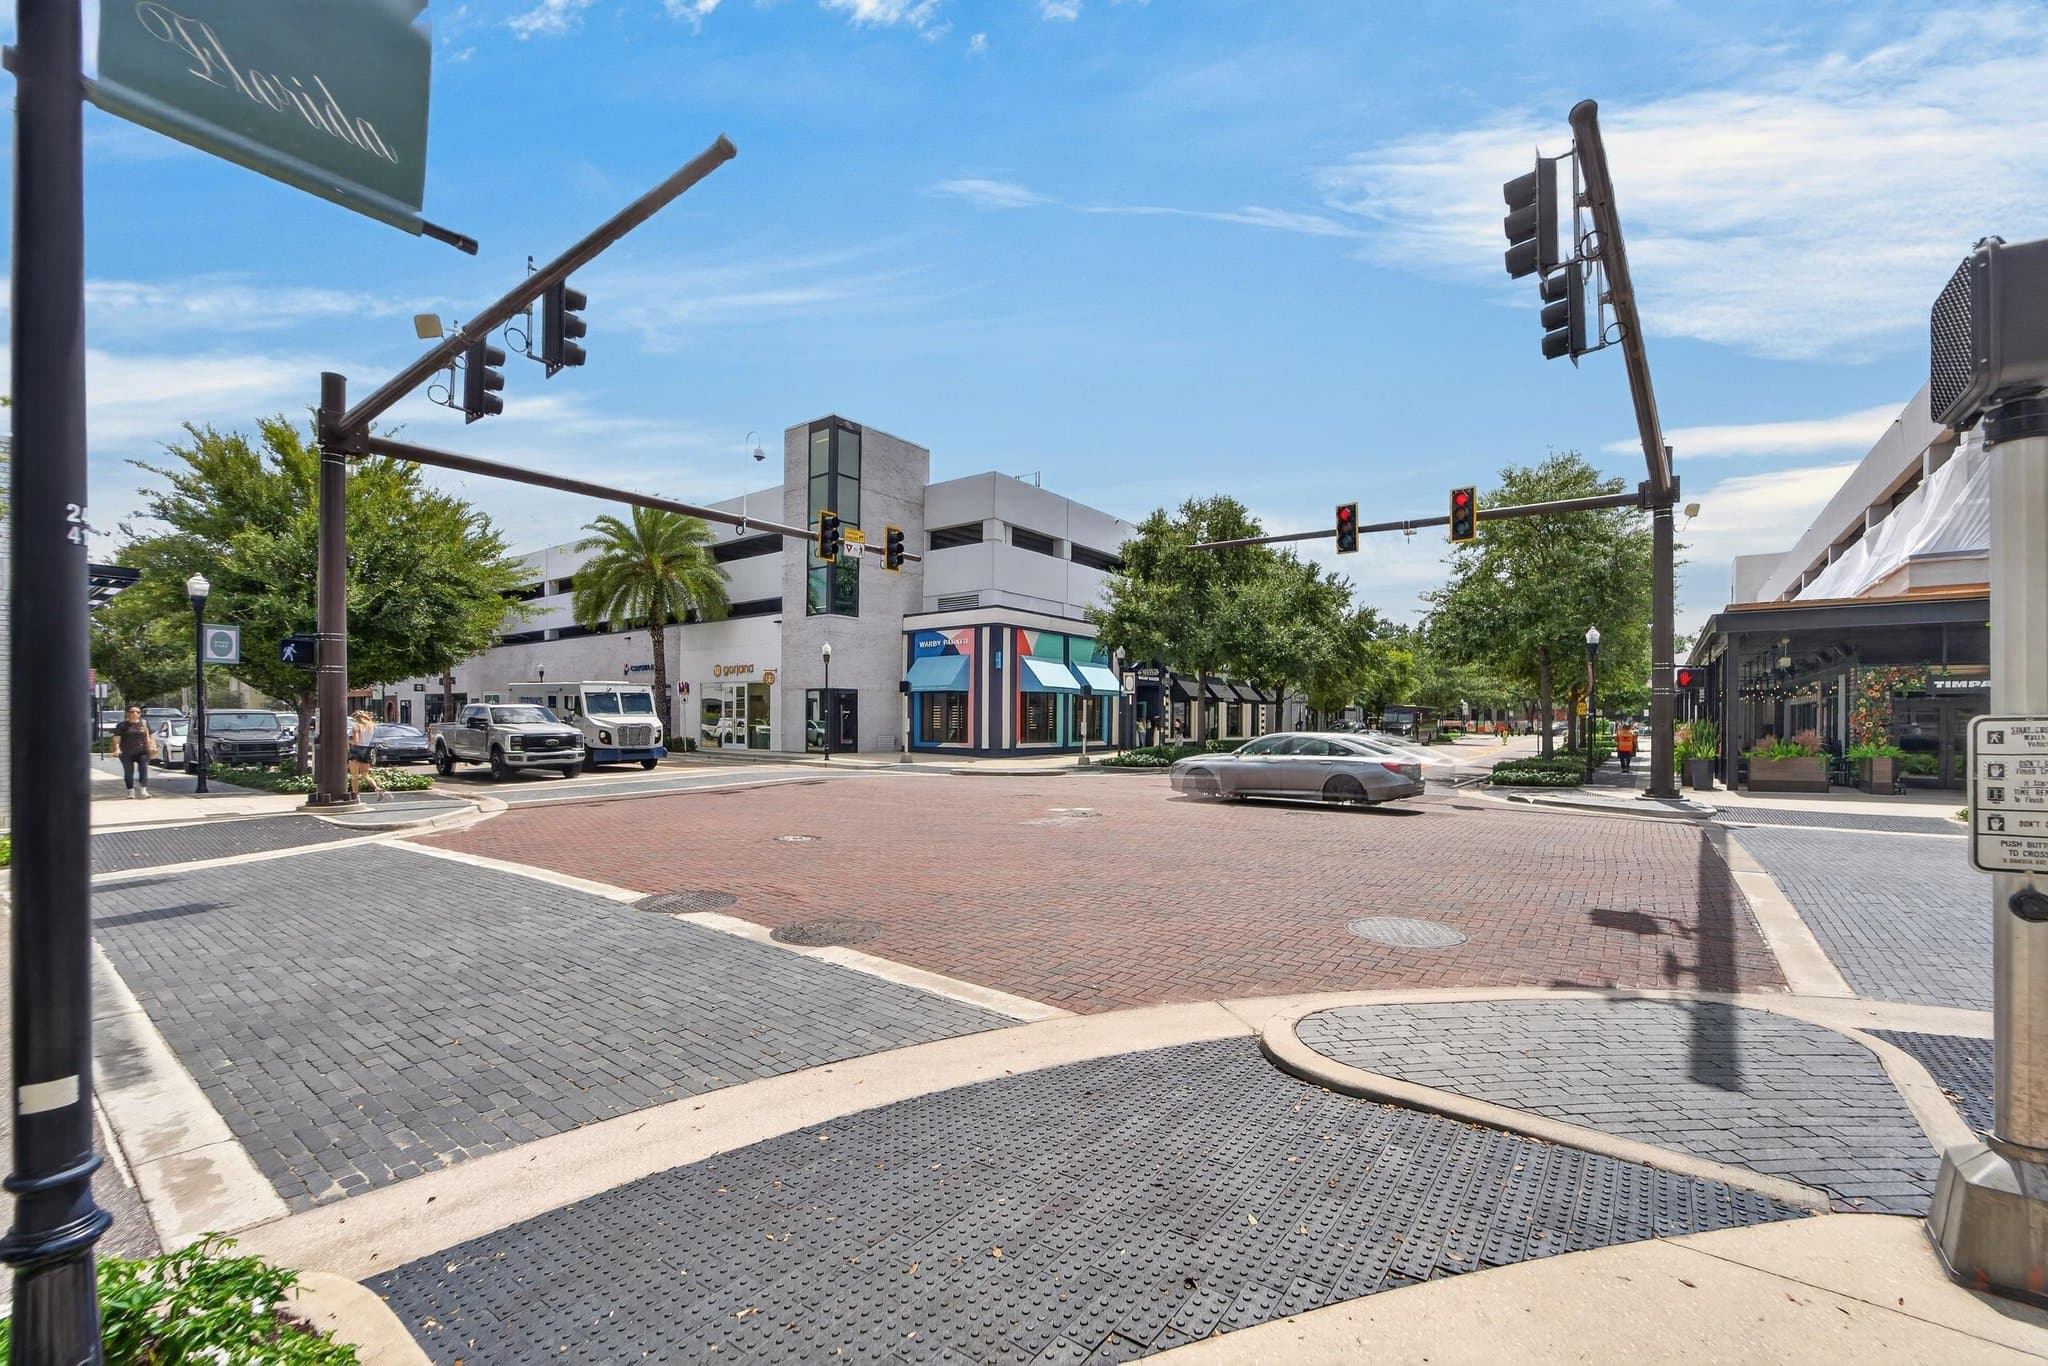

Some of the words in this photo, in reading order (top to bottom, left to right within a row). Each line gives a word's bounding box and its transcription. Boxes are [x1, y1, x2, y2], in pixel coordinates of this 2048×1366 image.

[919, 640, 941, 649] WARBY
[943, 638, 969, 647] PARKER
[723, 663, 754, 676] gorjana
[2000, 840, 2022, 848] PUSH
[2008, 849, 2019, 857] TO
